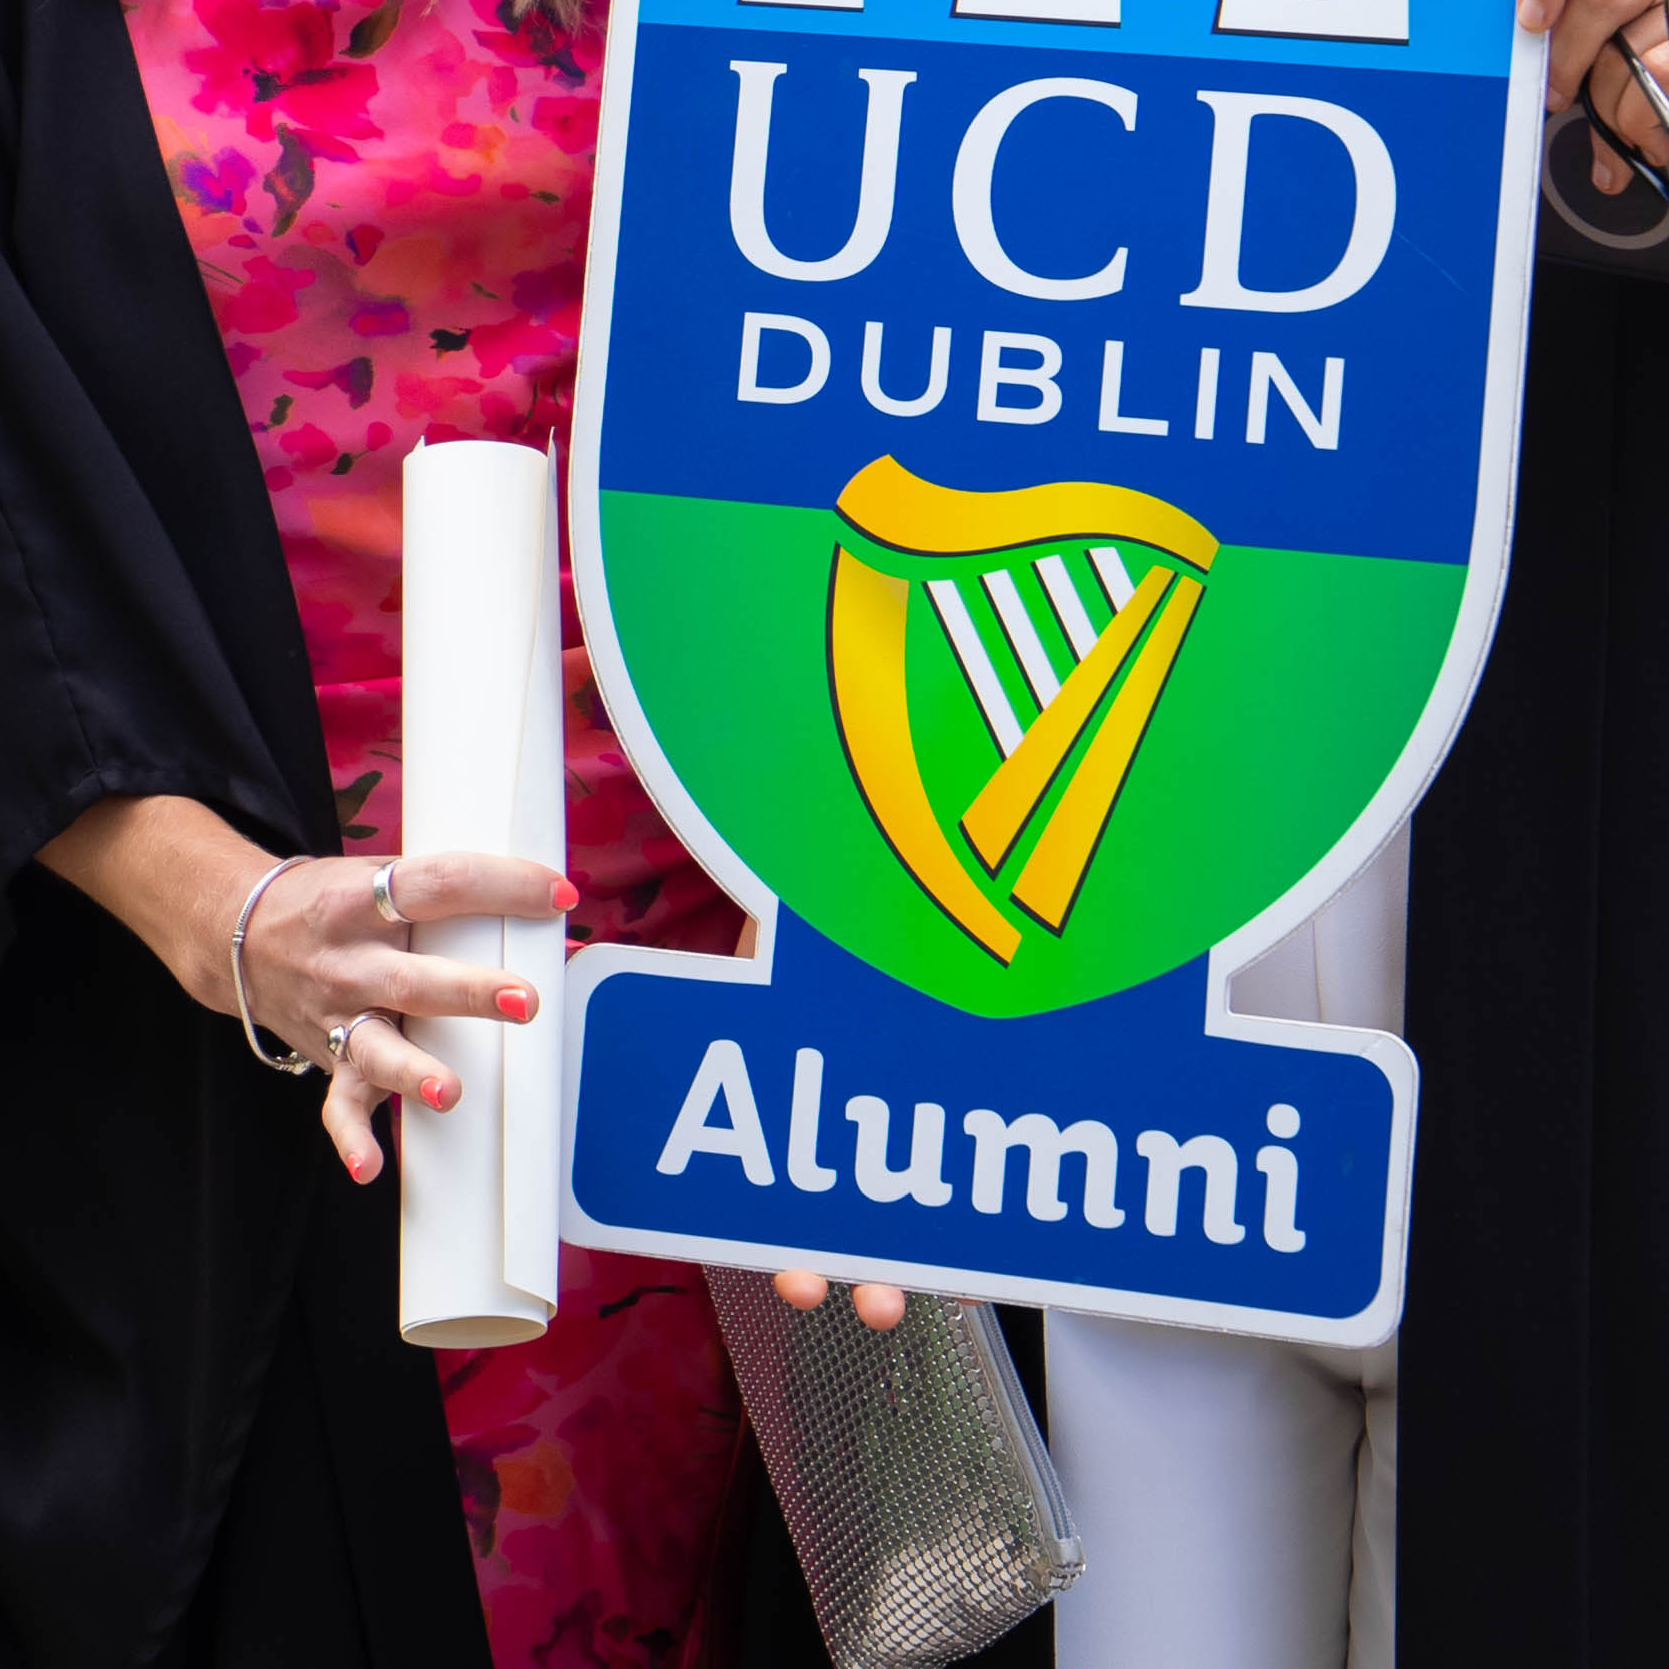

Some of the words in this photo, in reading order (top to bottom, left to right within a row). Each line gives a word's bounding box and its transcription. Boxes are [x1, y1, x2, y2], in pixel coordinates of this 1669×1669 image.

[730, 60, 1396, 313] UCD
[737, 311, 1344, 450] DUBLIN
[656, 1039, 1306, 1253] Alumni
